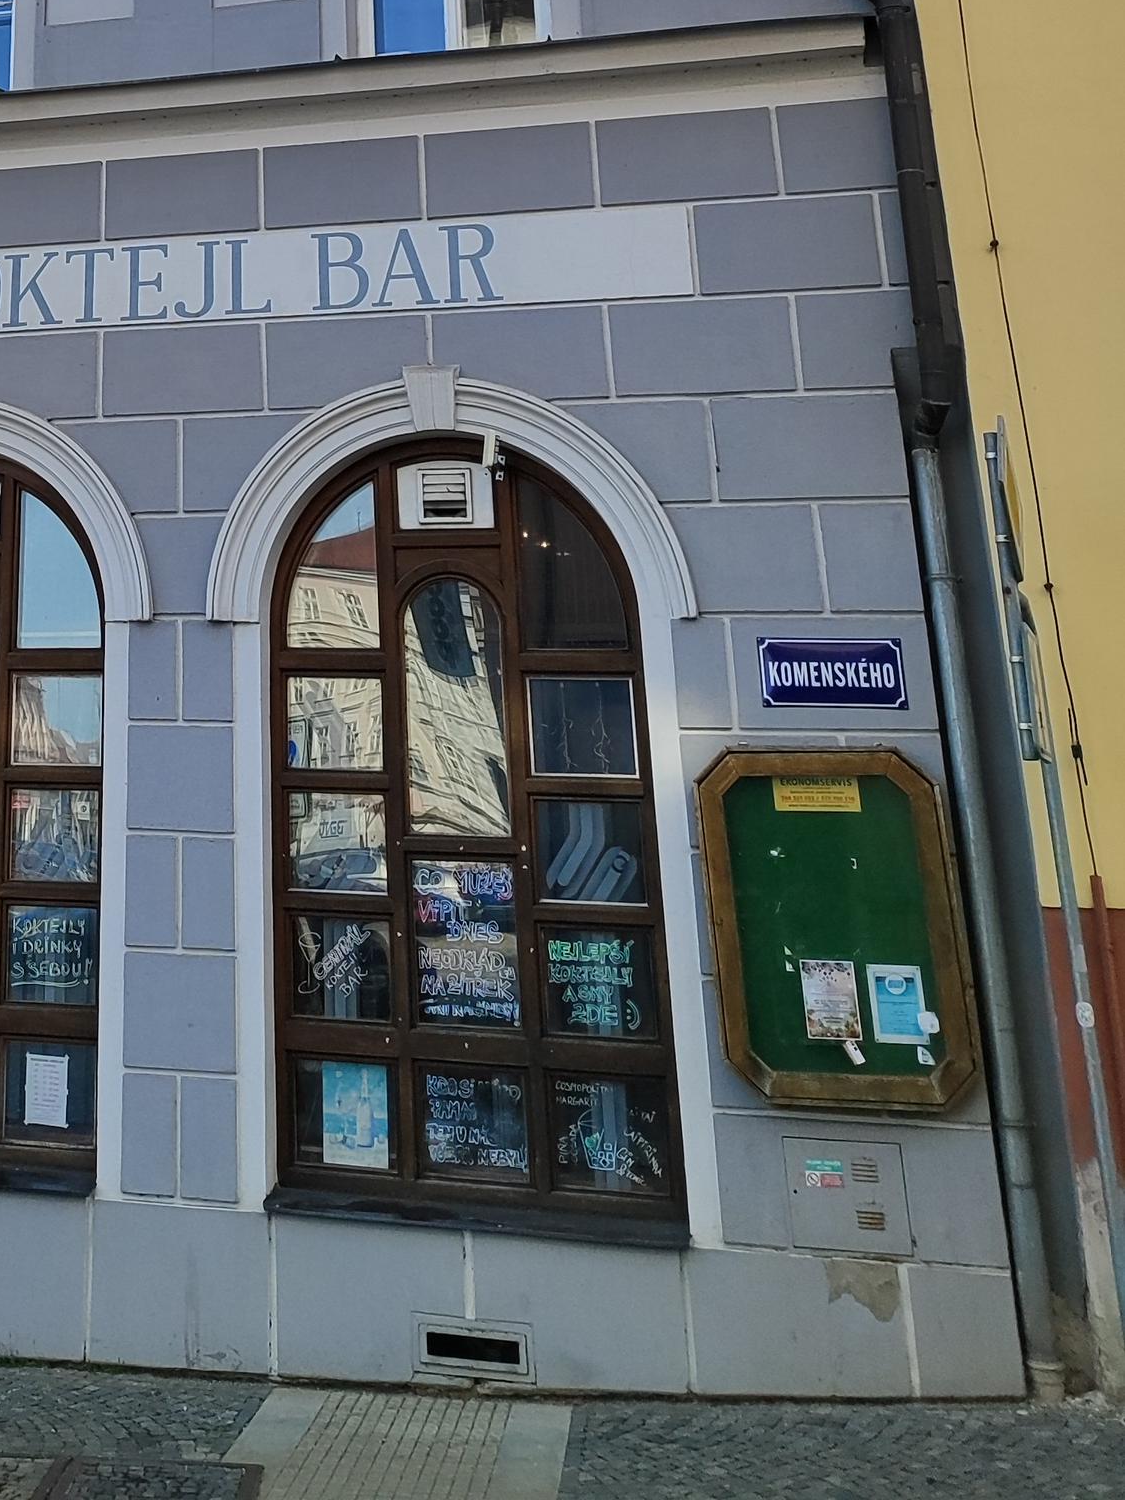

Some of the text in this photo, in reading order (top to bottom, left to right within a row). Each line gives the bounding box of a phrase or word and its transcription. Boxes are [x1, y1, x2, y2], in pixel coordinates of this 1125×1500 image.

[311, 222, 505, 311] BAR
[768, 658, 896, 689] KOMENSKÉHO
[338, 965, 369, 998] BAR
